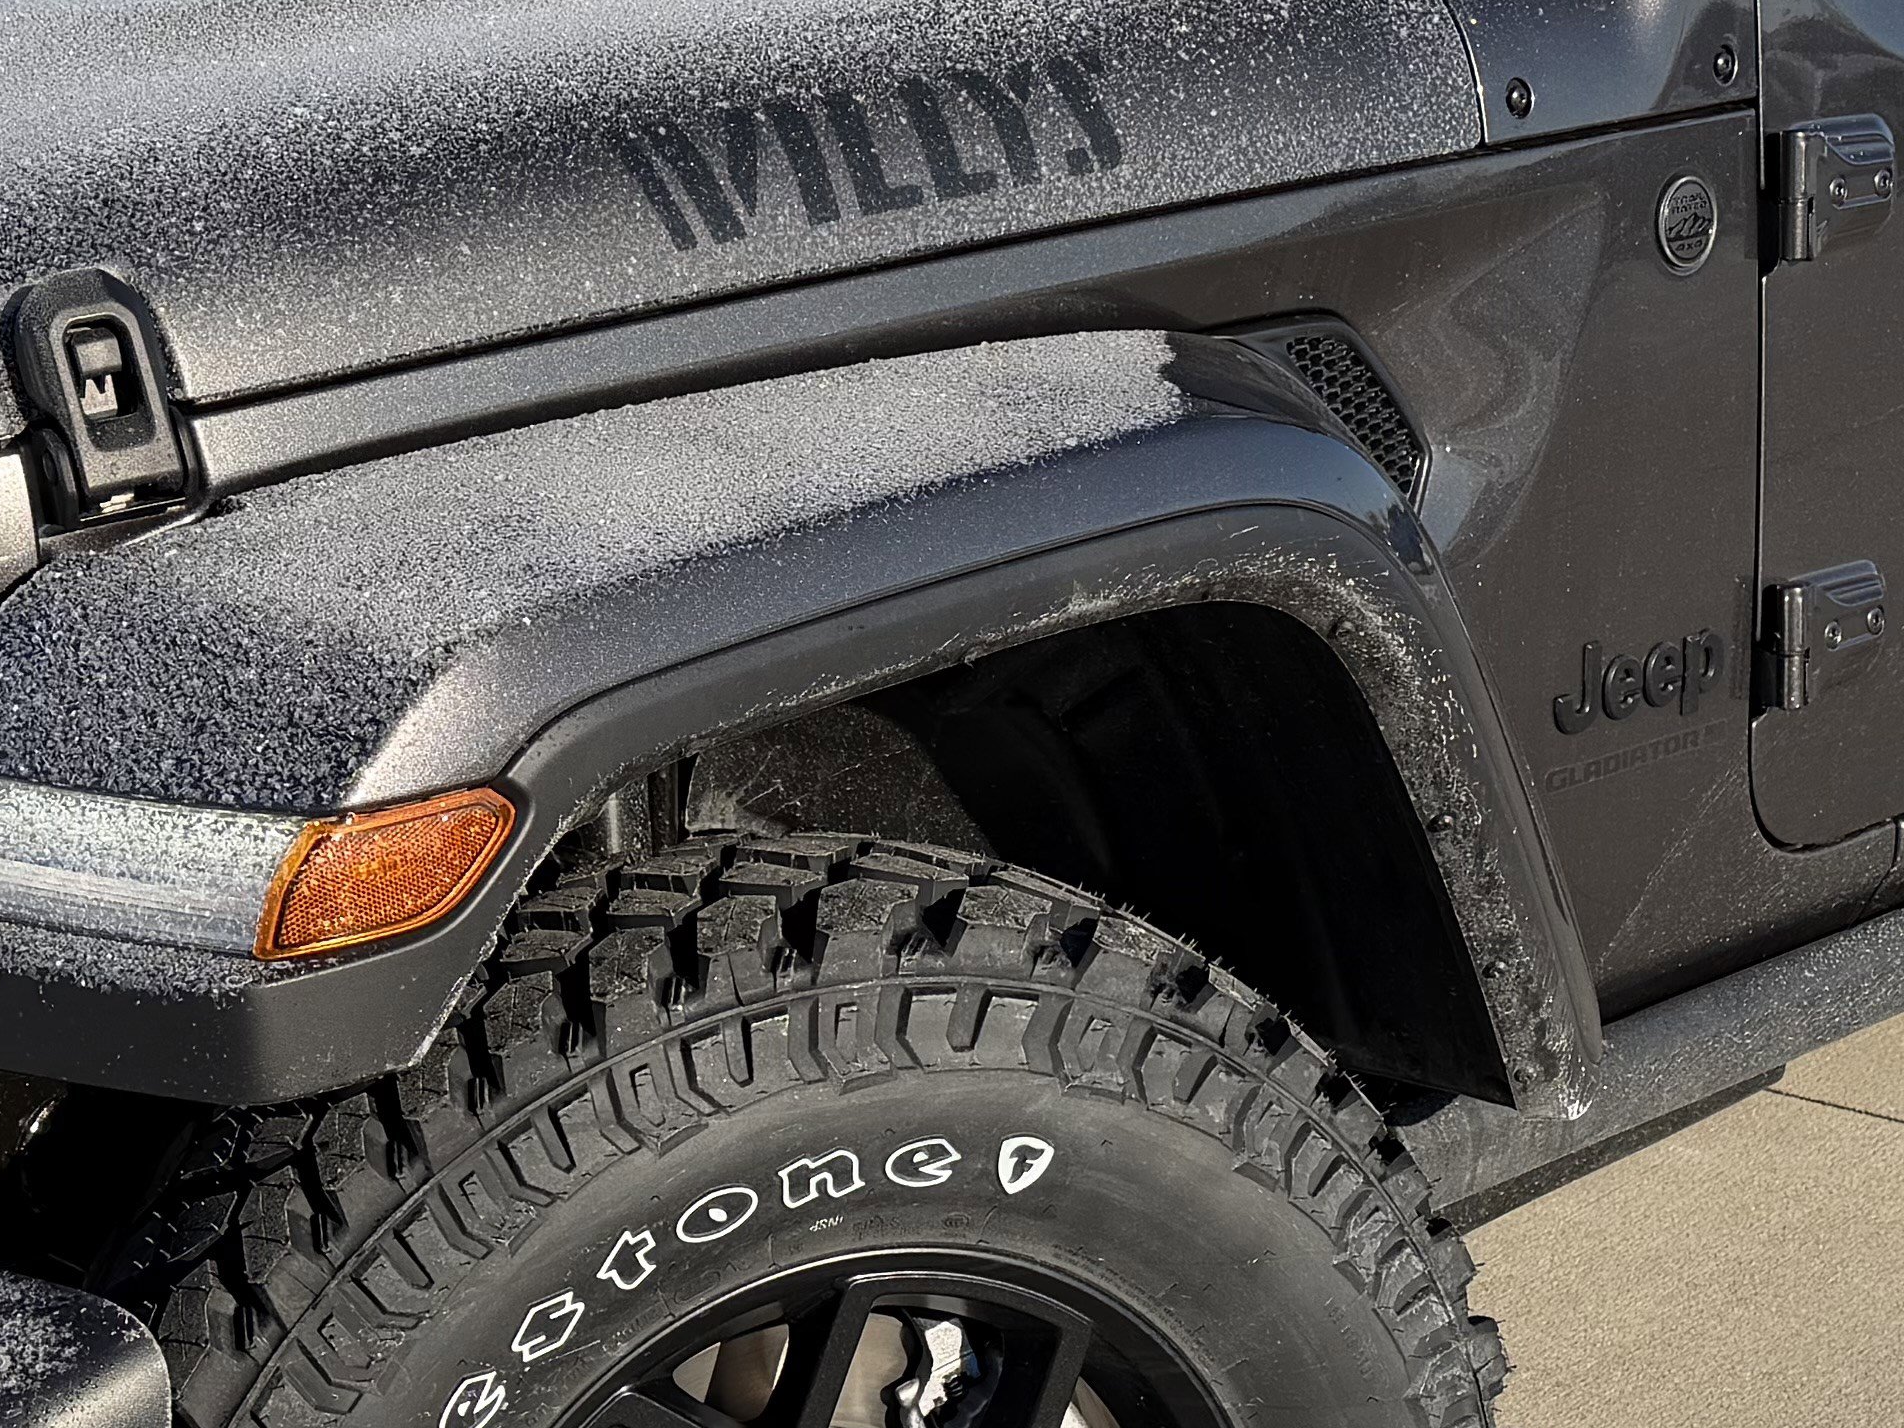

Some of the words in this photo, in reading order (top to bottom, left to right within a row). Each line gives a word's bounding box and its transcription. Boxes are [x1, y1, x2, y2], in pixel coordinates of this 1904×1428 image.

[615, 52, 1121, 252] WILLYS
[1553, 628, 1725, 736] Jeep
[1546, 728, 1701, 793] GLADIATOR
